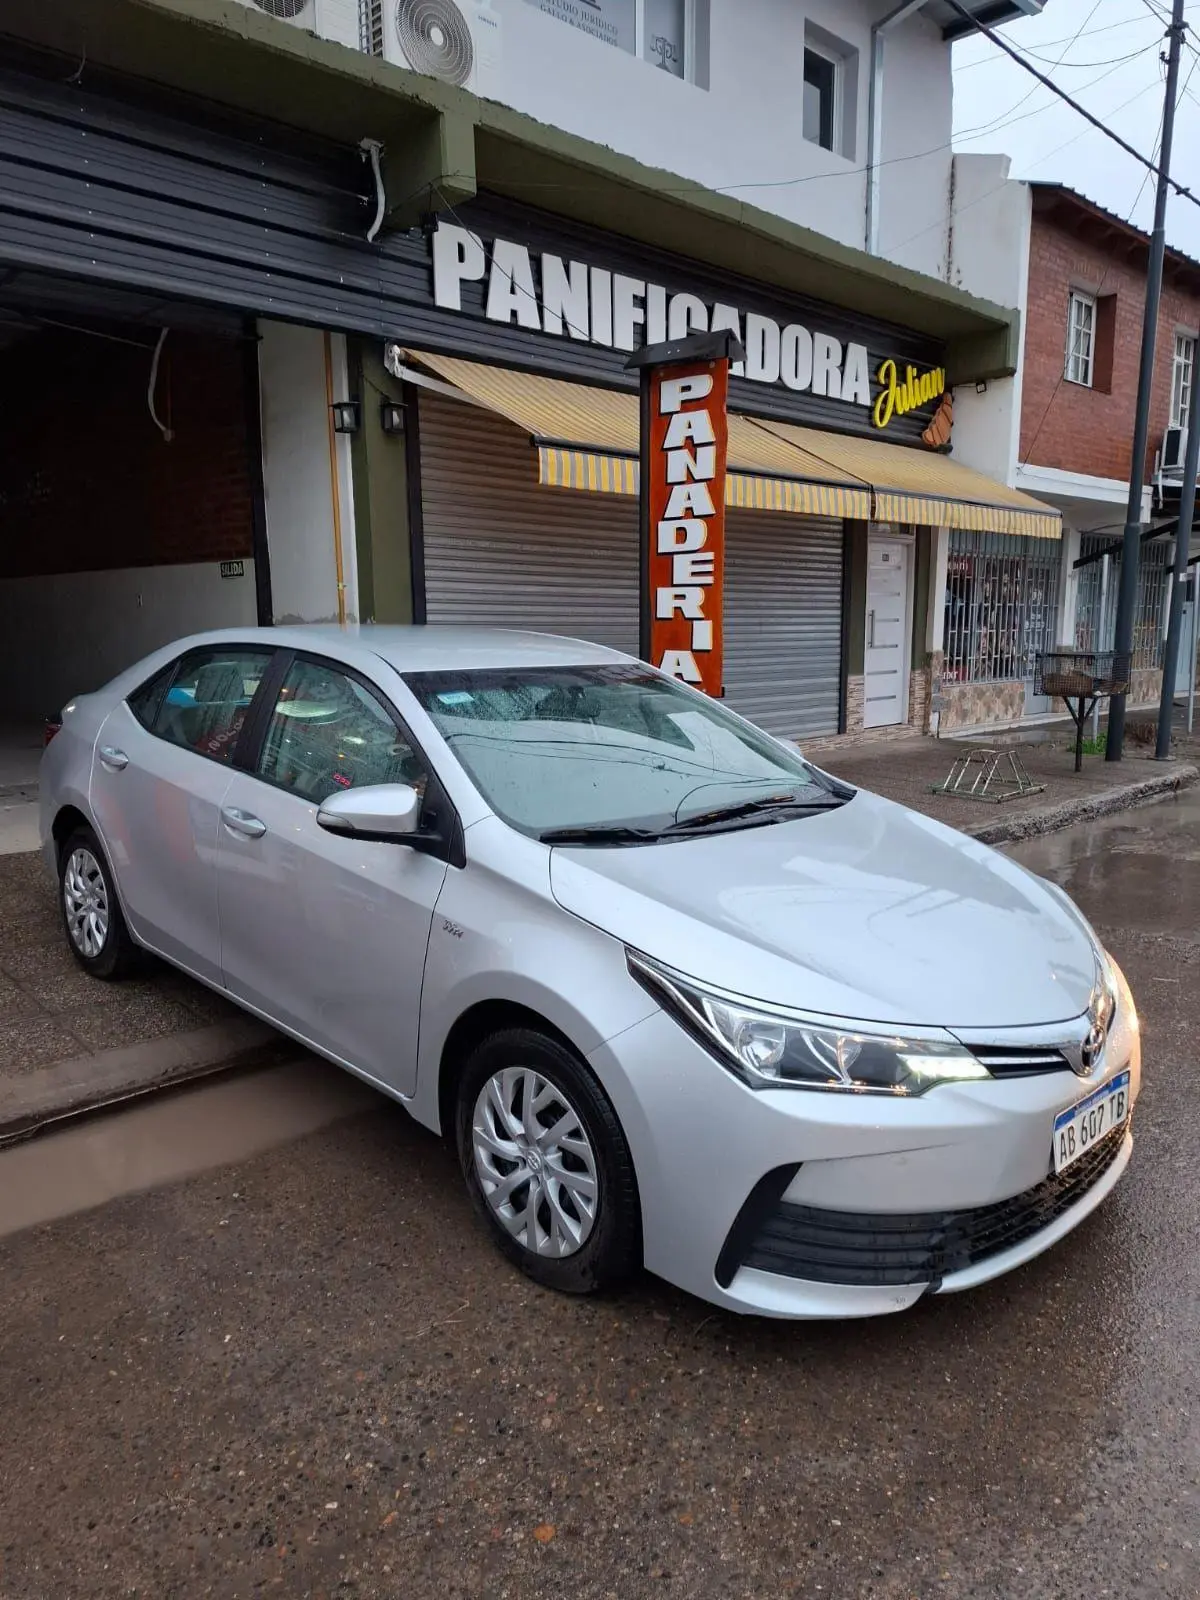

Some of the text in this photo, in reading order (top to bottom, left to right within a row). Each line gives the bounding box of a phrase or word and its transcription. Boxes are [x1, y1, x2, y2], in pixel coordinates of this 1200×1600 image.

[873, 359, 946, 428] Julian
[656, 374, 717, 682] PANADERIA
[1060, 1125, 1076, 1164] AB
[1081, 1102, 1105, 1146] 607
[1109, 1091, 1125, 1125] TB
